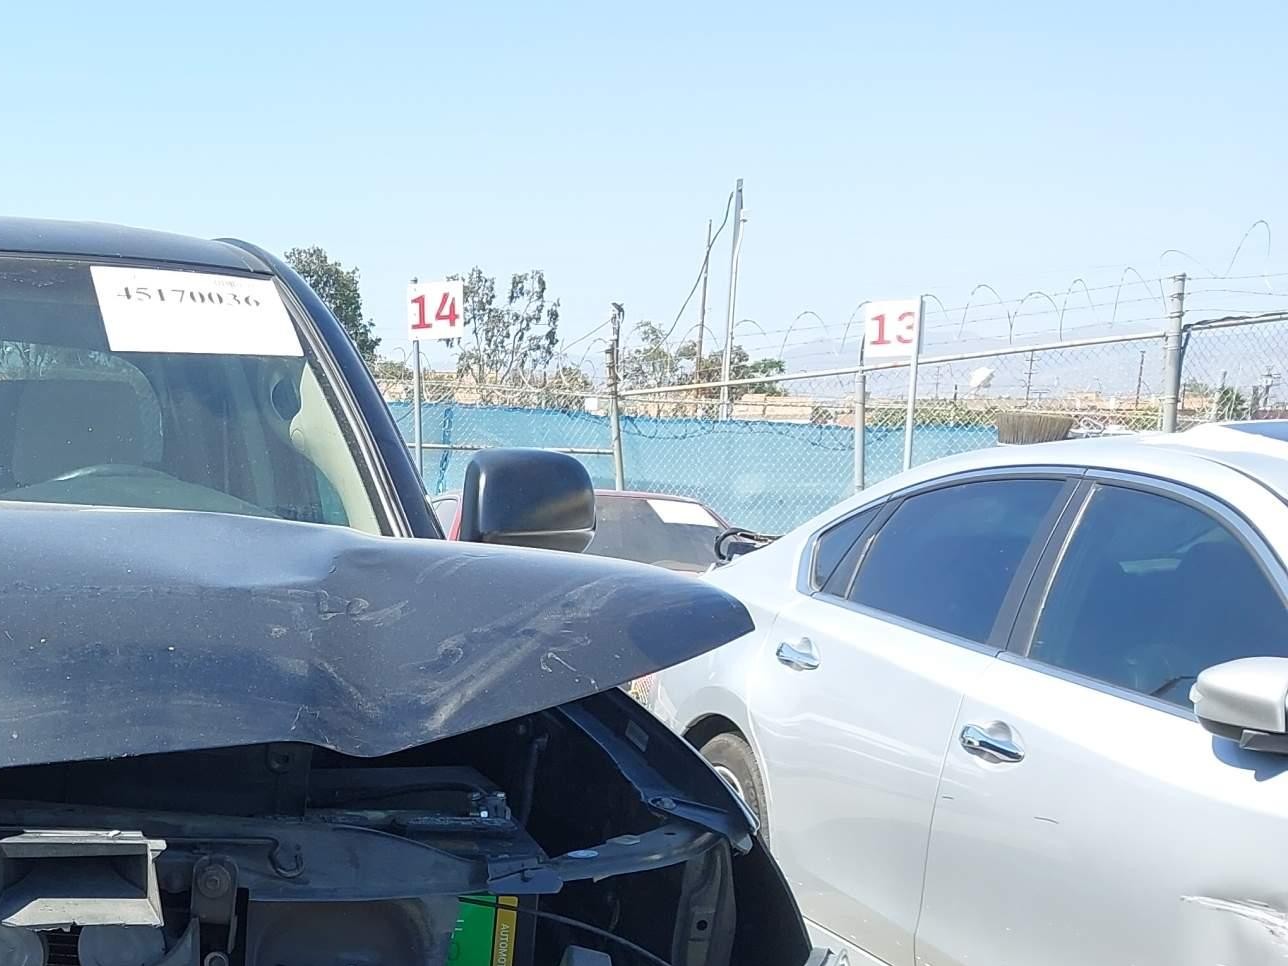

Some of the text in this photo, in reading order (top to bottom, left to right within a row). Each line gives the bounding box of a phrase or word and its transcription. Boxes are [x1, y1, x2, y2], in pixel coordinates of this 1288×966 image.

[117, 286, 261, 307] 45170036
[411, 292, 460, 329] 14
[870, 311, 915, 345] 13
